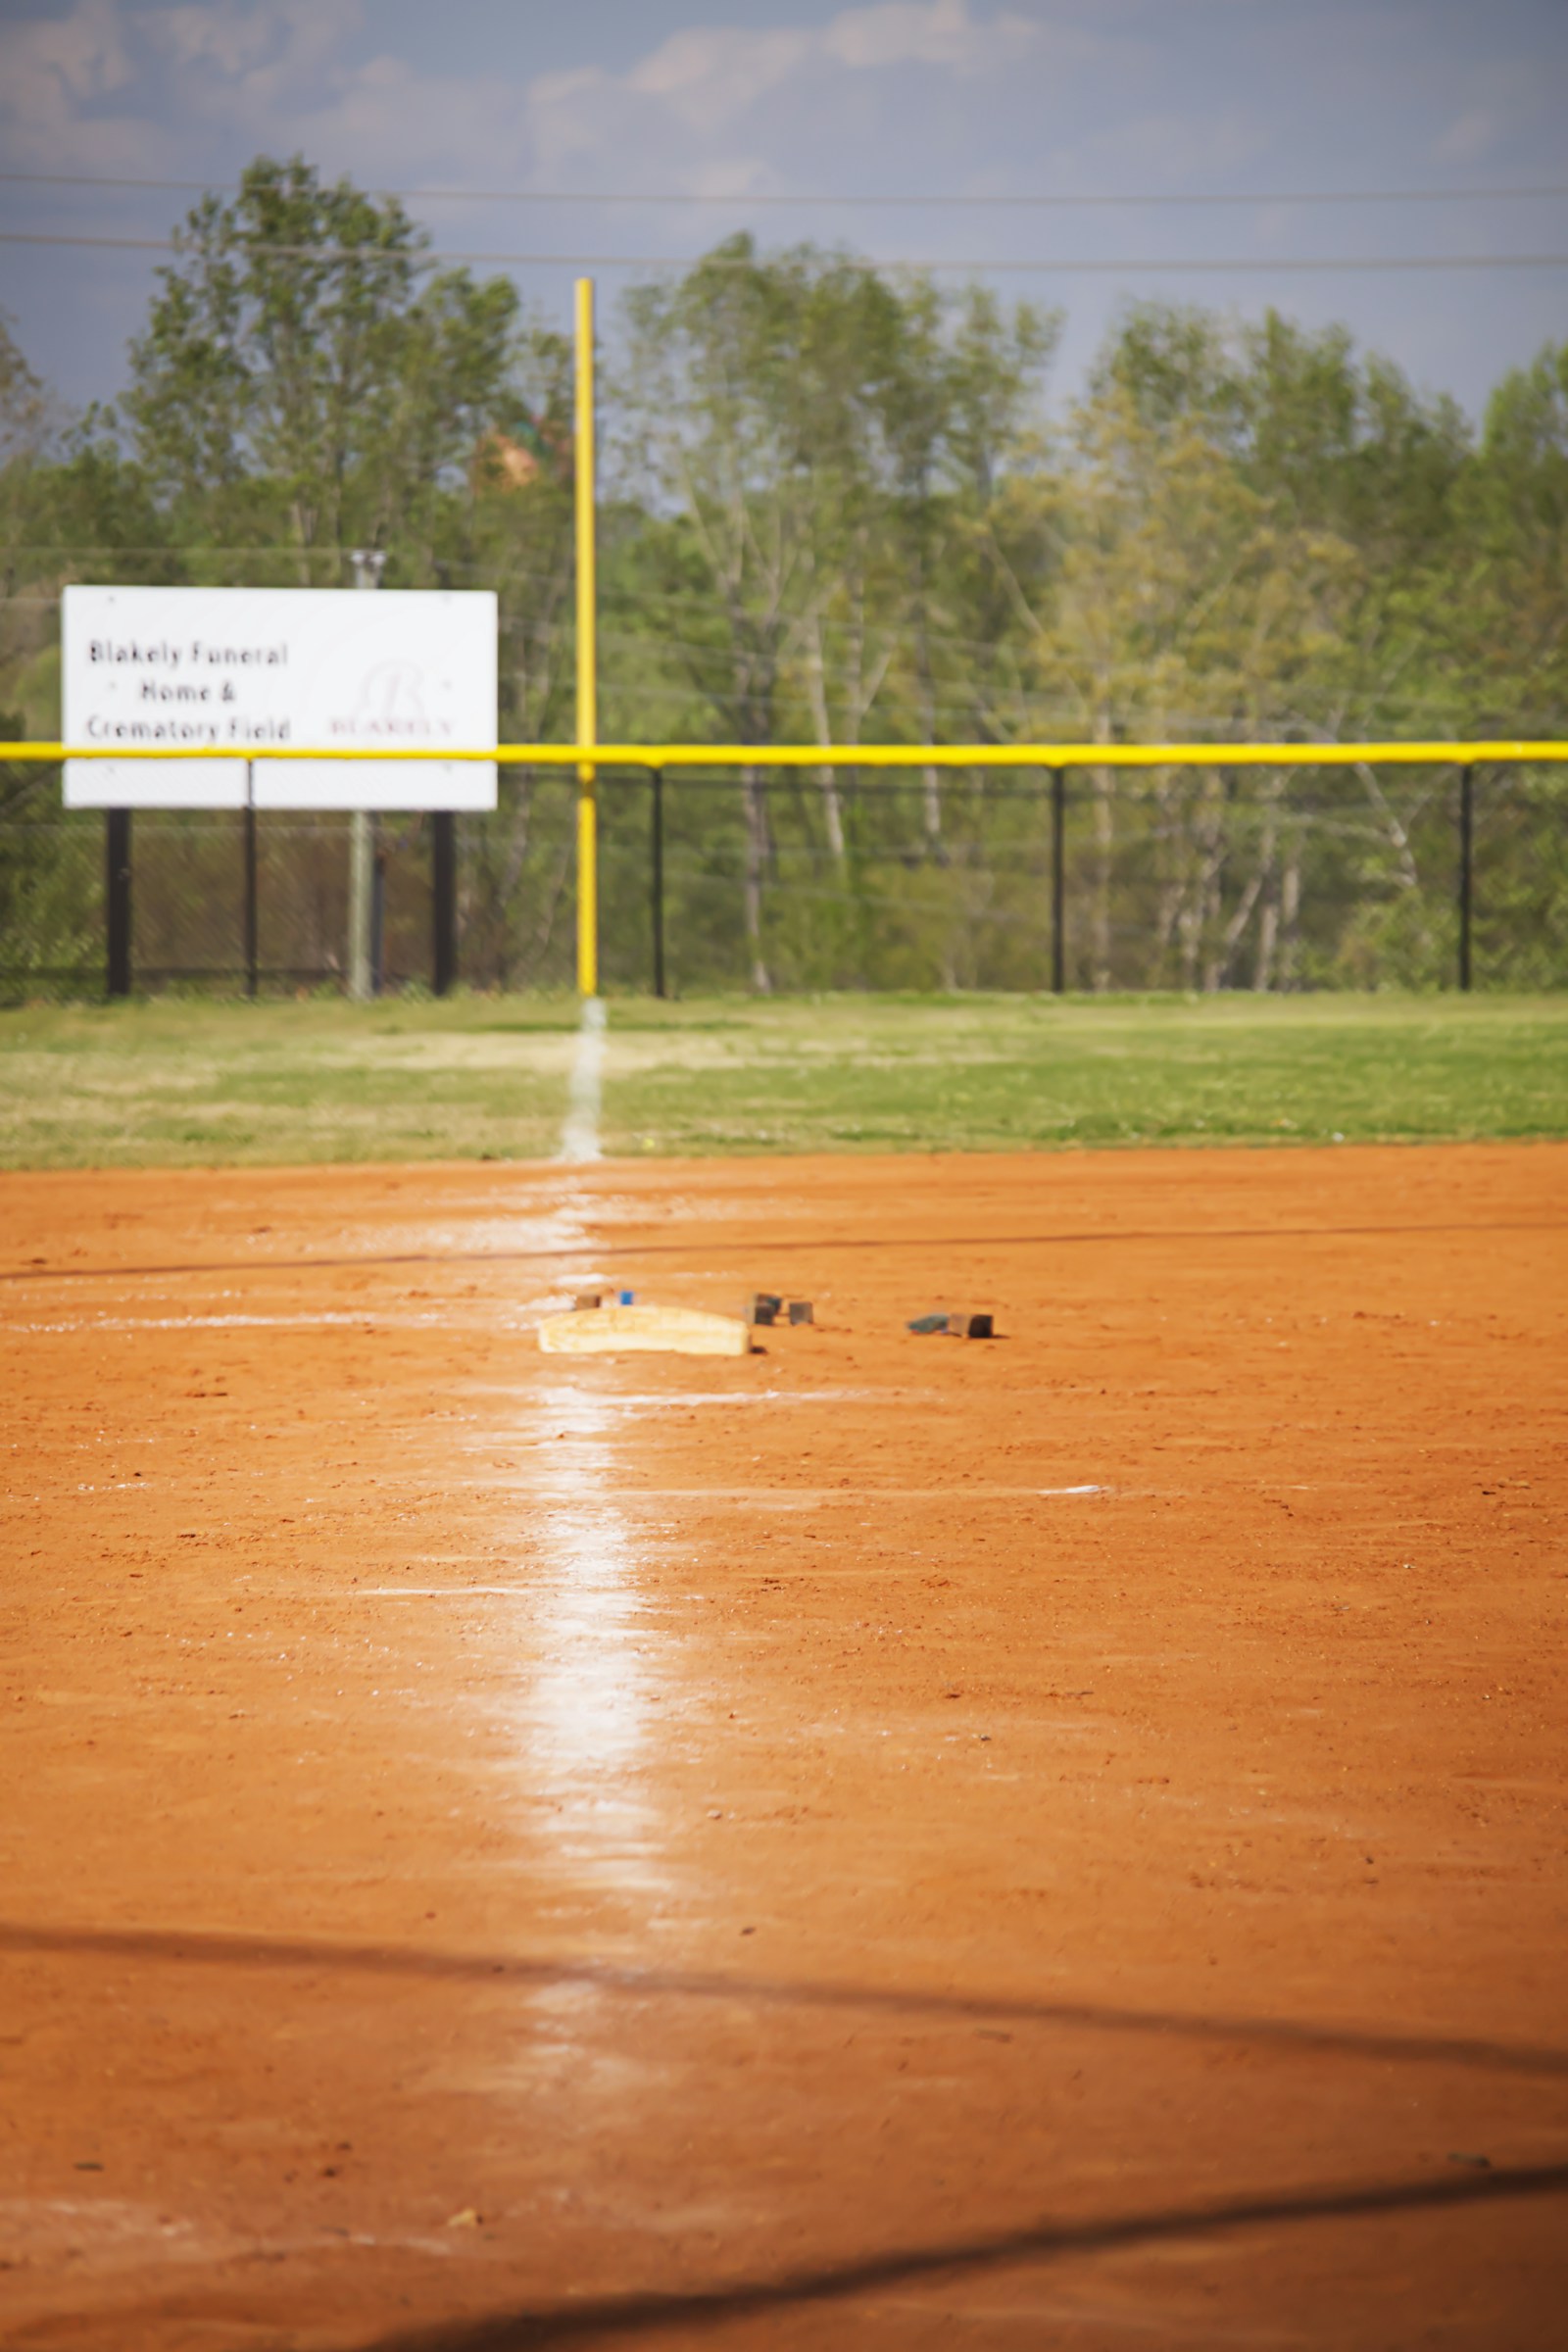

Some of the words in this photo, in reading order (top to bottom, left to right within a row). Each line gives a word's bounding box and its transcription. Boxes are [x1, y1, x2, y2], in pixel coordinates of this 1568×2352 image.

[89, 640, 180, 669] Blakely
[192, 641, 289, 666] Funeral
[140, 681, 210, 702] Home
[221, 681, 236, 702] &
[86, 715, 217, 744] Crematory
[230, 716, 291, 741] Field
